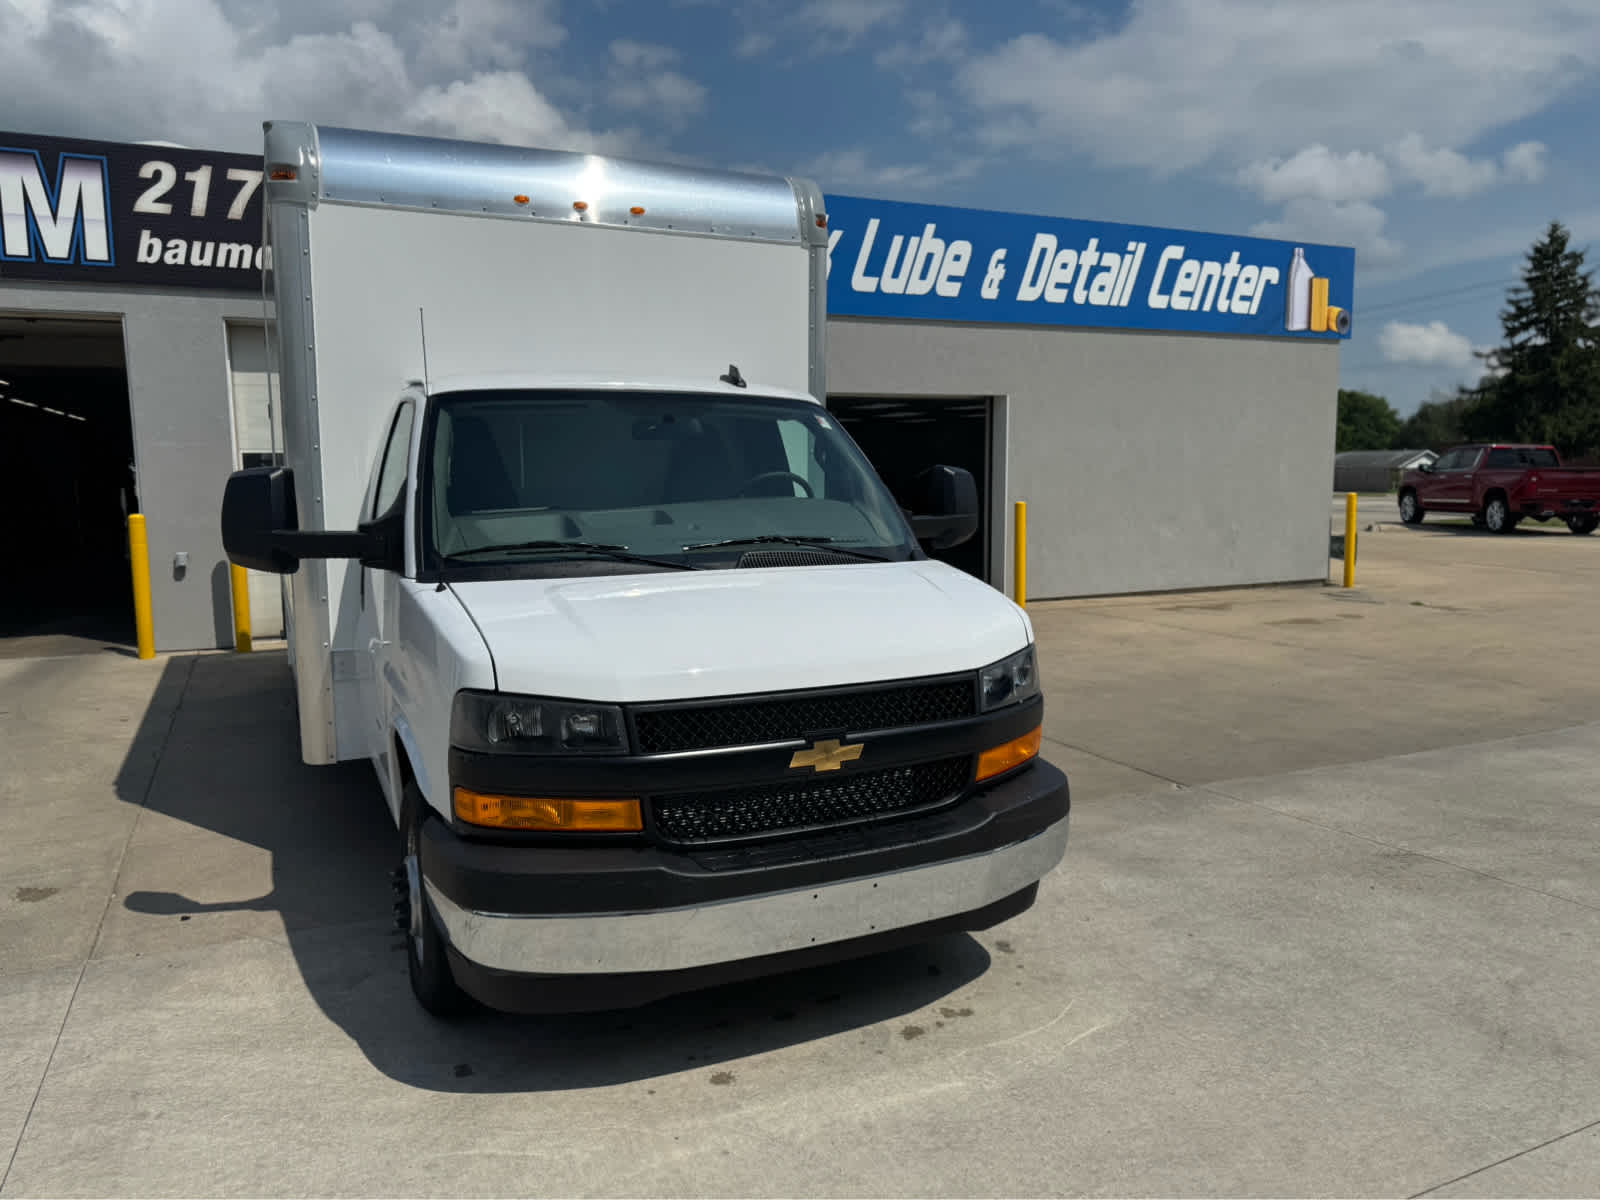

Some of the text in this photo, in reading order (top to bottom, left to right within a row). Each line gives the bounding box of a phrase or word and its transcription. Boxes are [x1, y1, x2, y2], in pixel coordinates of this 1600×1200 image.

[133, 160, 263, 220] 217
[851, 218, 972, 297] Lube
[980, 248, 1007, 299] &
[1016, 232, 1147, 306] Detail
[1148, 245, 1279, 315] Center
